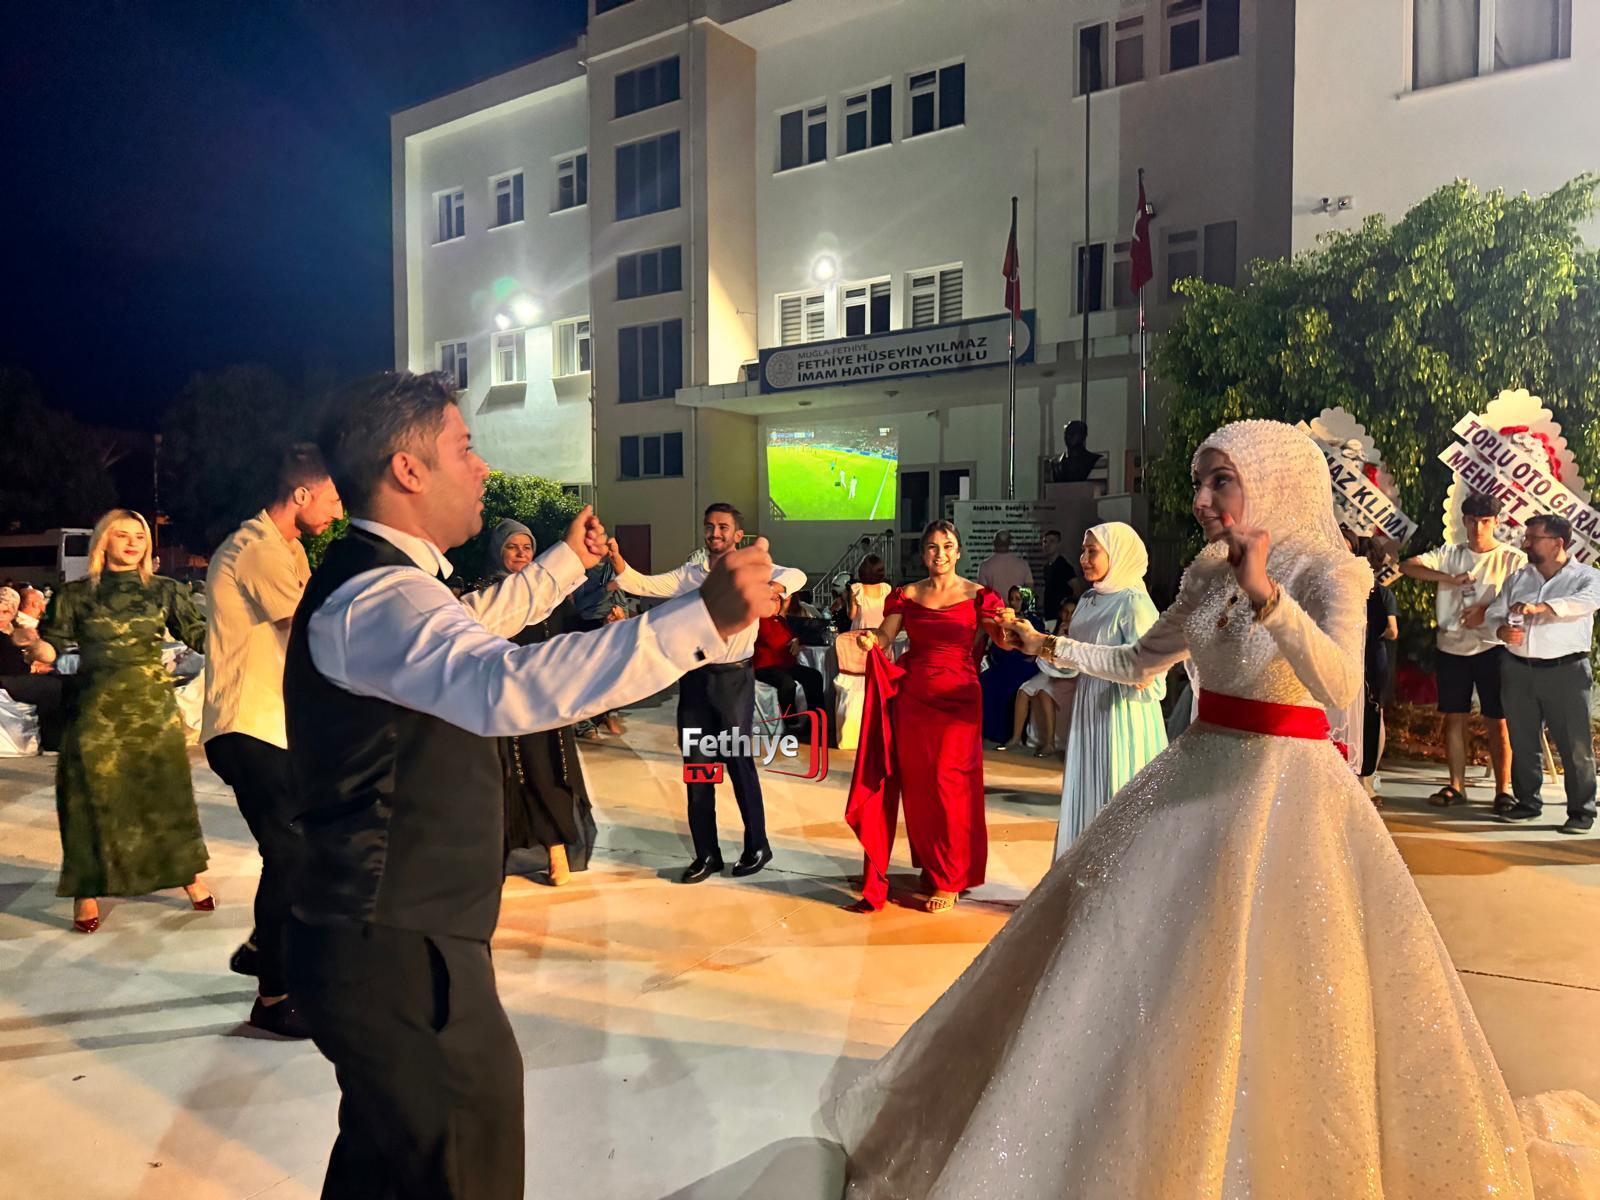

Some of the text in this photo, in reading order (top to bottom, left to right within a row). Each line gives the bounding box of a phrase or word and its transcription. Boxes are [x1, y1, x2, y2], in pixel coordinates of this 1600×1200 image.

[797, 336, 988, 371] FETHİYE HÜSEYİN YILMAZ
[797, 350, 988, 382] İMAM HATİP ORTAOKULU
[1446, 449, 1528, 515] MEHMET
[1463, 420, 1517, 468] TOPLU
[1512, 463, 1552, 496] OTO
[1351, 485, 1409, 543] KLİMA
